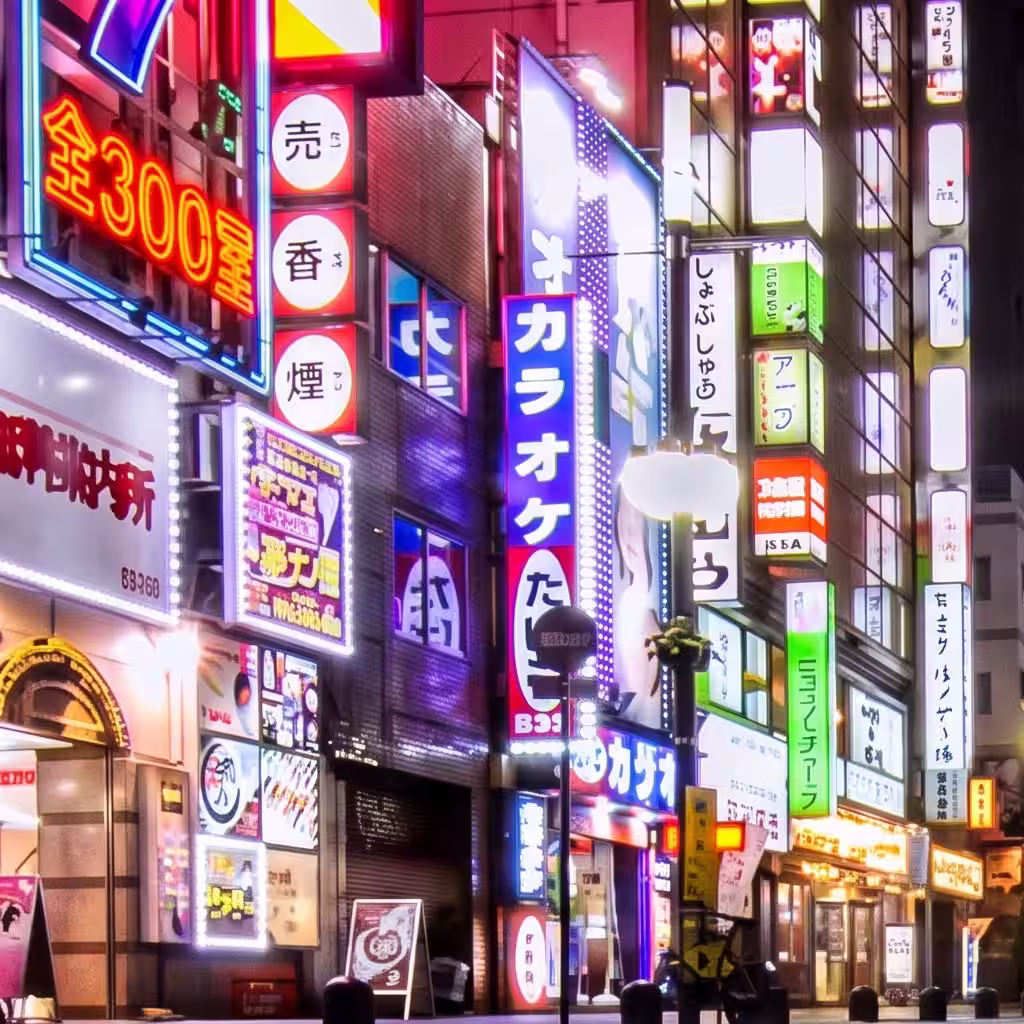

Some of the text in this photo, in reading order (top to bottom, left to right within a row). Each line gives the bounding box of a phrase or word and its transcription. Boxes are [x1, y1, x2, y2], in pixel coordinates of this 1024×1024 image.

[287, 361, 324, 402] 煙
[514, 303, 571, 545] カラオケ
